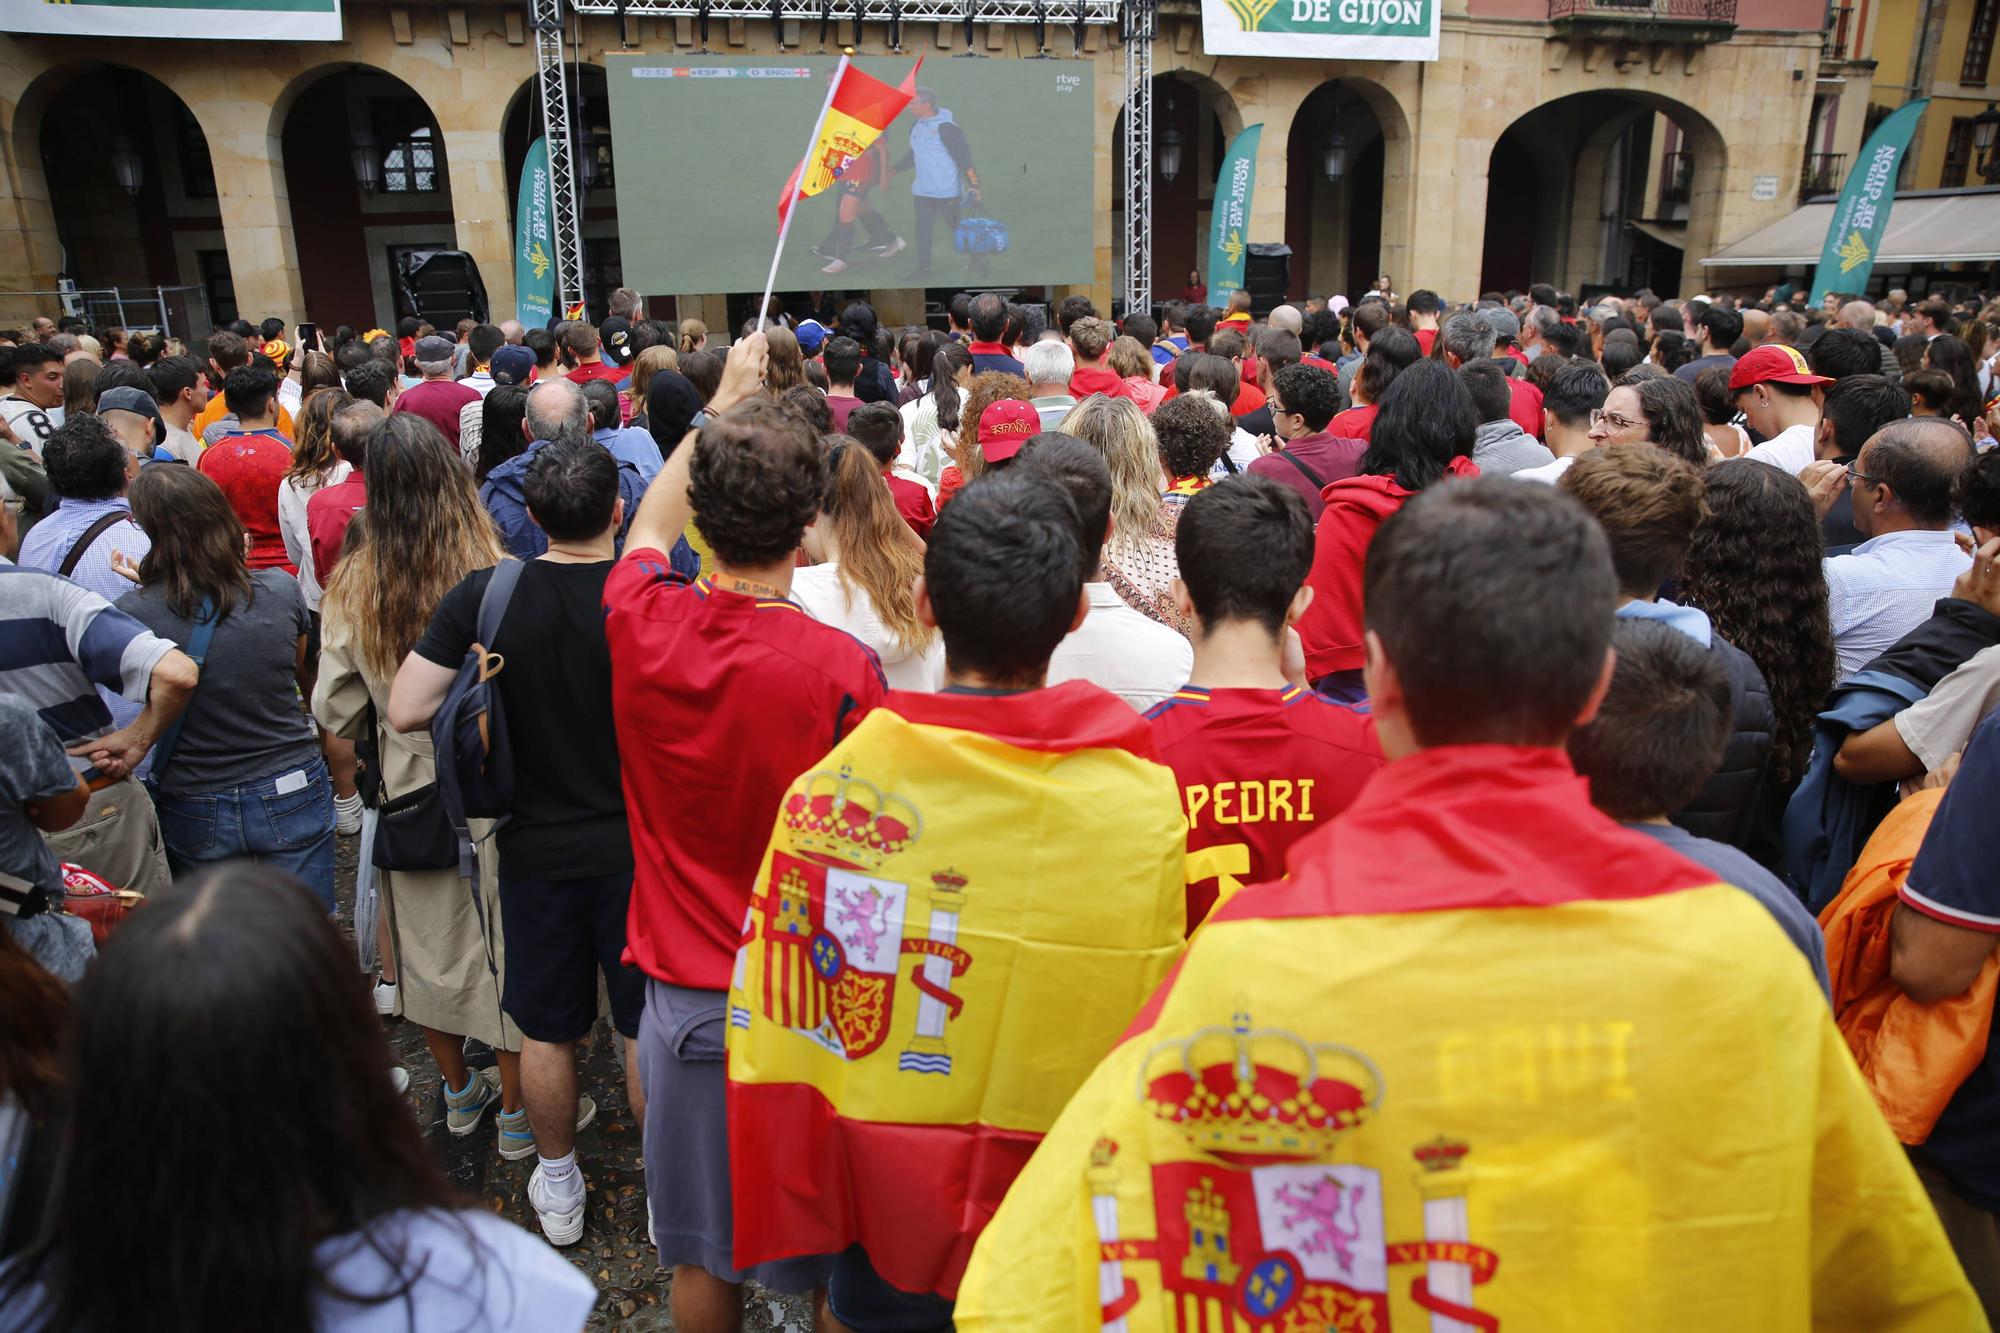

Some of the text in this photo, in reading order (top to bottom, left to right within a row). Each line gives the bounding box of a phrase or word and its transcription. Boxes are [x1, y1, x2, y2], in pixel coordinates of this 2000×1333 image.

[1291, 0, 1331, 22] DE
[1056, 74, 1080, 86] rtve
[534, 166, 542, 208] RURAL
[1232, 157, 1242, 197] RURAL
[1852, 144, 1888, 228] CAJA RURAL
[539, 219, 547, 241] DE
[1236, 207, 1243, 228] DE
[1861, 205, 1877, 230] DE
[28, 412, 54, 440] 8
[991, 418, 1032, 435] ESPAÑA
[1186, 779, 1315, 830] PEDRI
